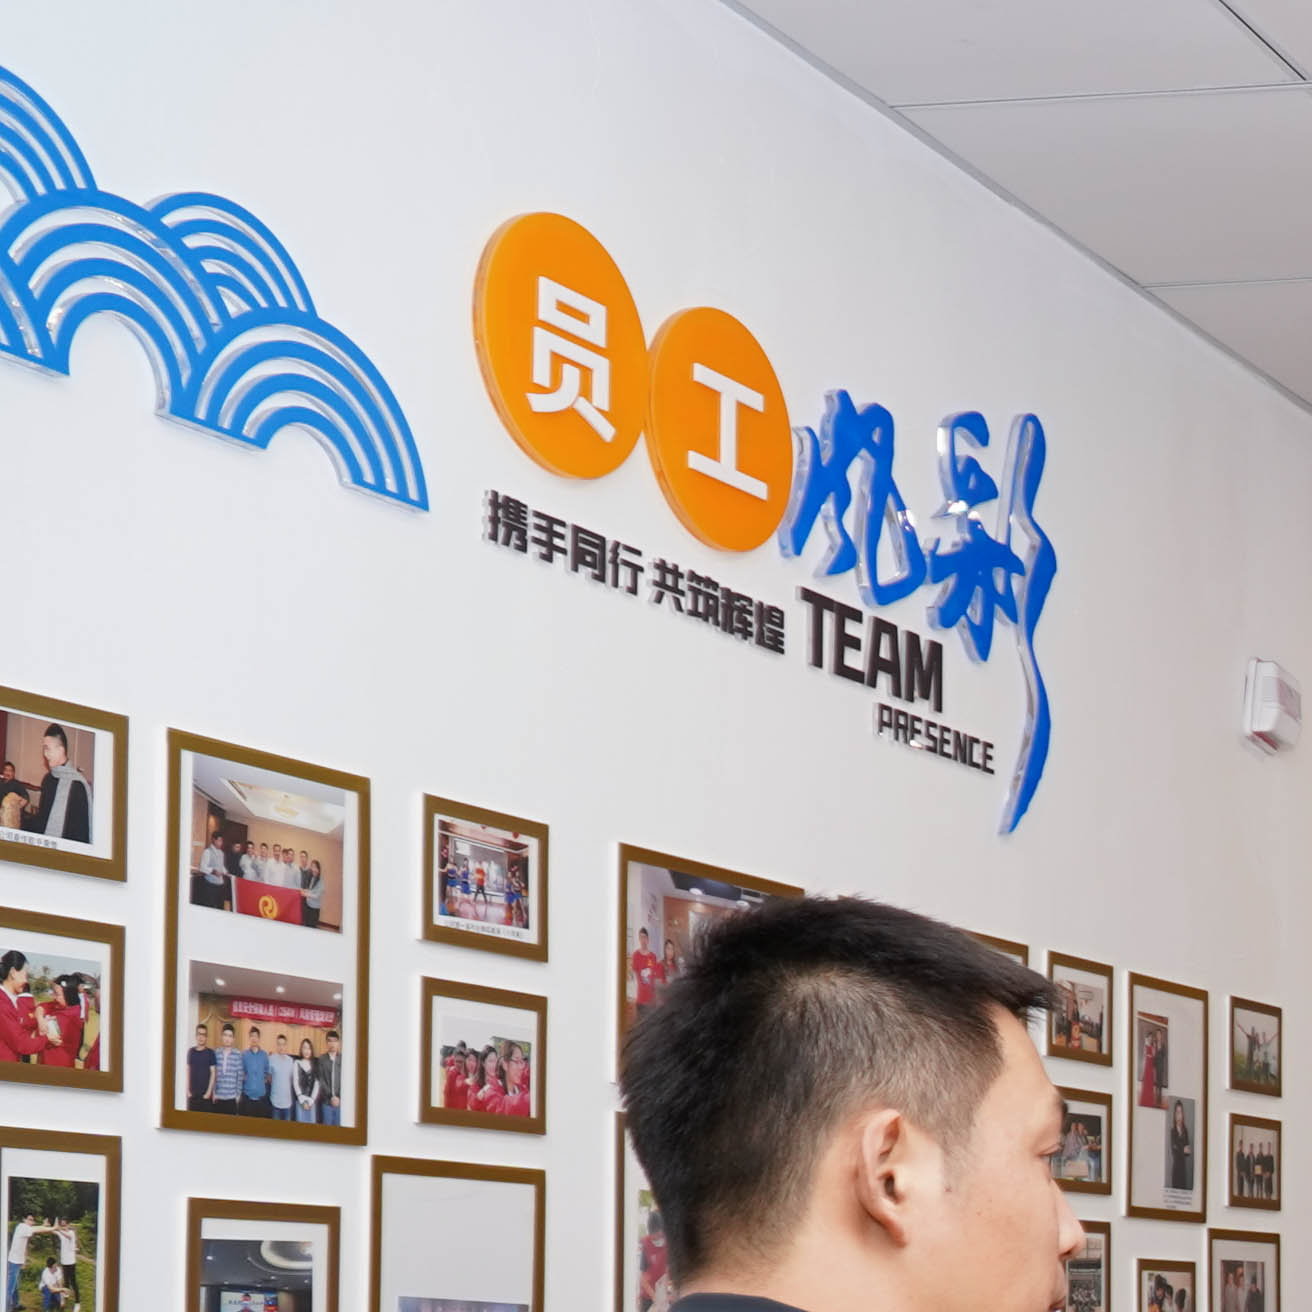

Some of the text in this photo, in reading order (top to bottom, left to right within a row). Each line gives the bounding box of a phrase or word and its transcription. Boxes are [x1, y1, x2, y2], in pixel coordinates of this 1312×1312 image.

[481, 488, 787, 658] 携手同行 共筑辉煌
[796, 584, 944, 715] TEAM
[873, 703, 996, 776] PRESENCE
